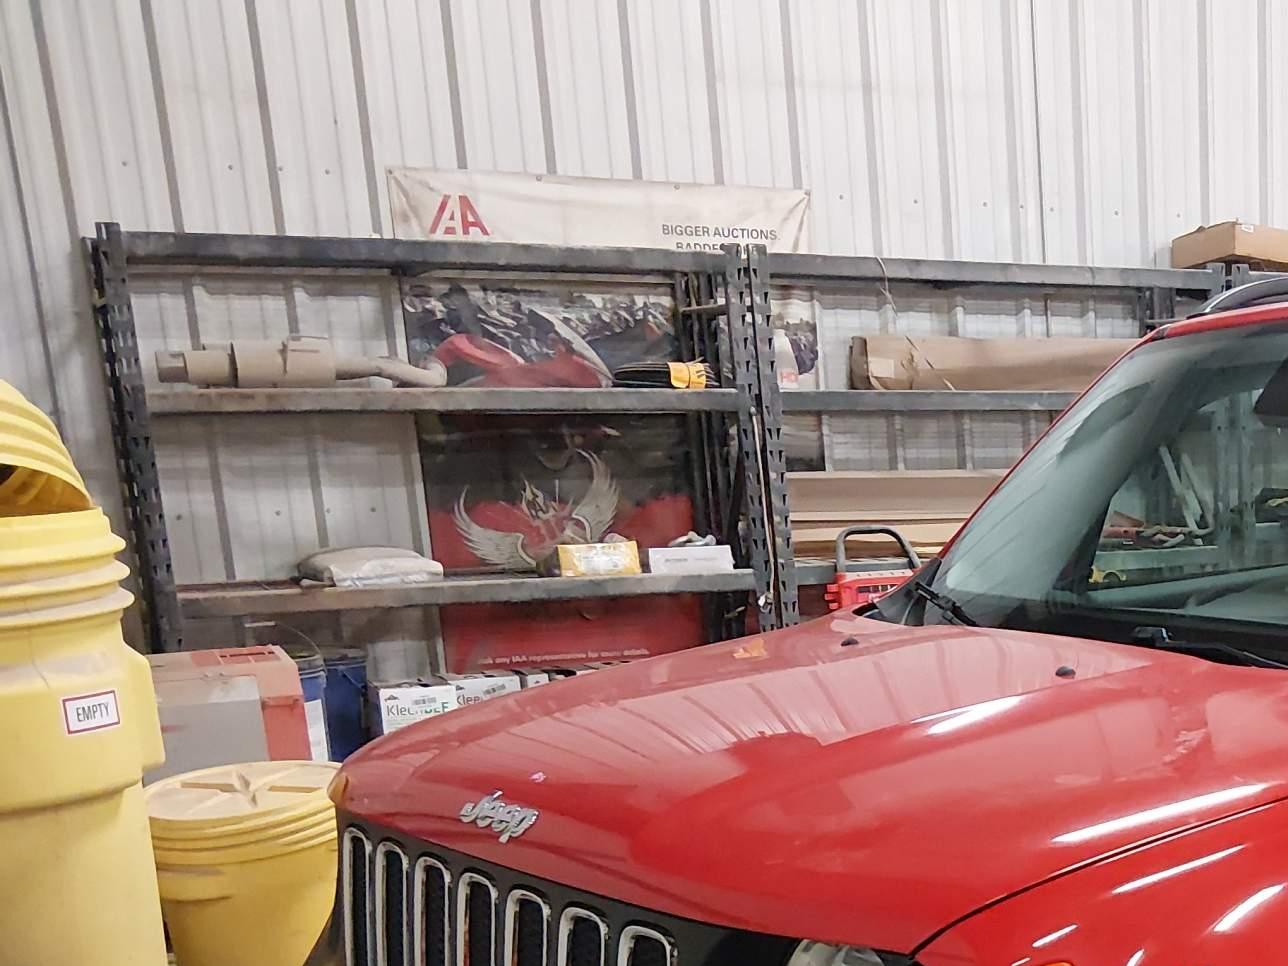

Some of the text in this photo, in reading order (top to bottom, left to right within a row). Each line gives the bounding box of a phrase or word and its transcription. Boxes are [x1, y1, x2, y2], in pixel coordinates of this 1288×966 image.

[661, 223, 710, 238] BIGGER
[76, 701, 110, 723] EMPTY
[460, 790, 539, 844] Jeep
